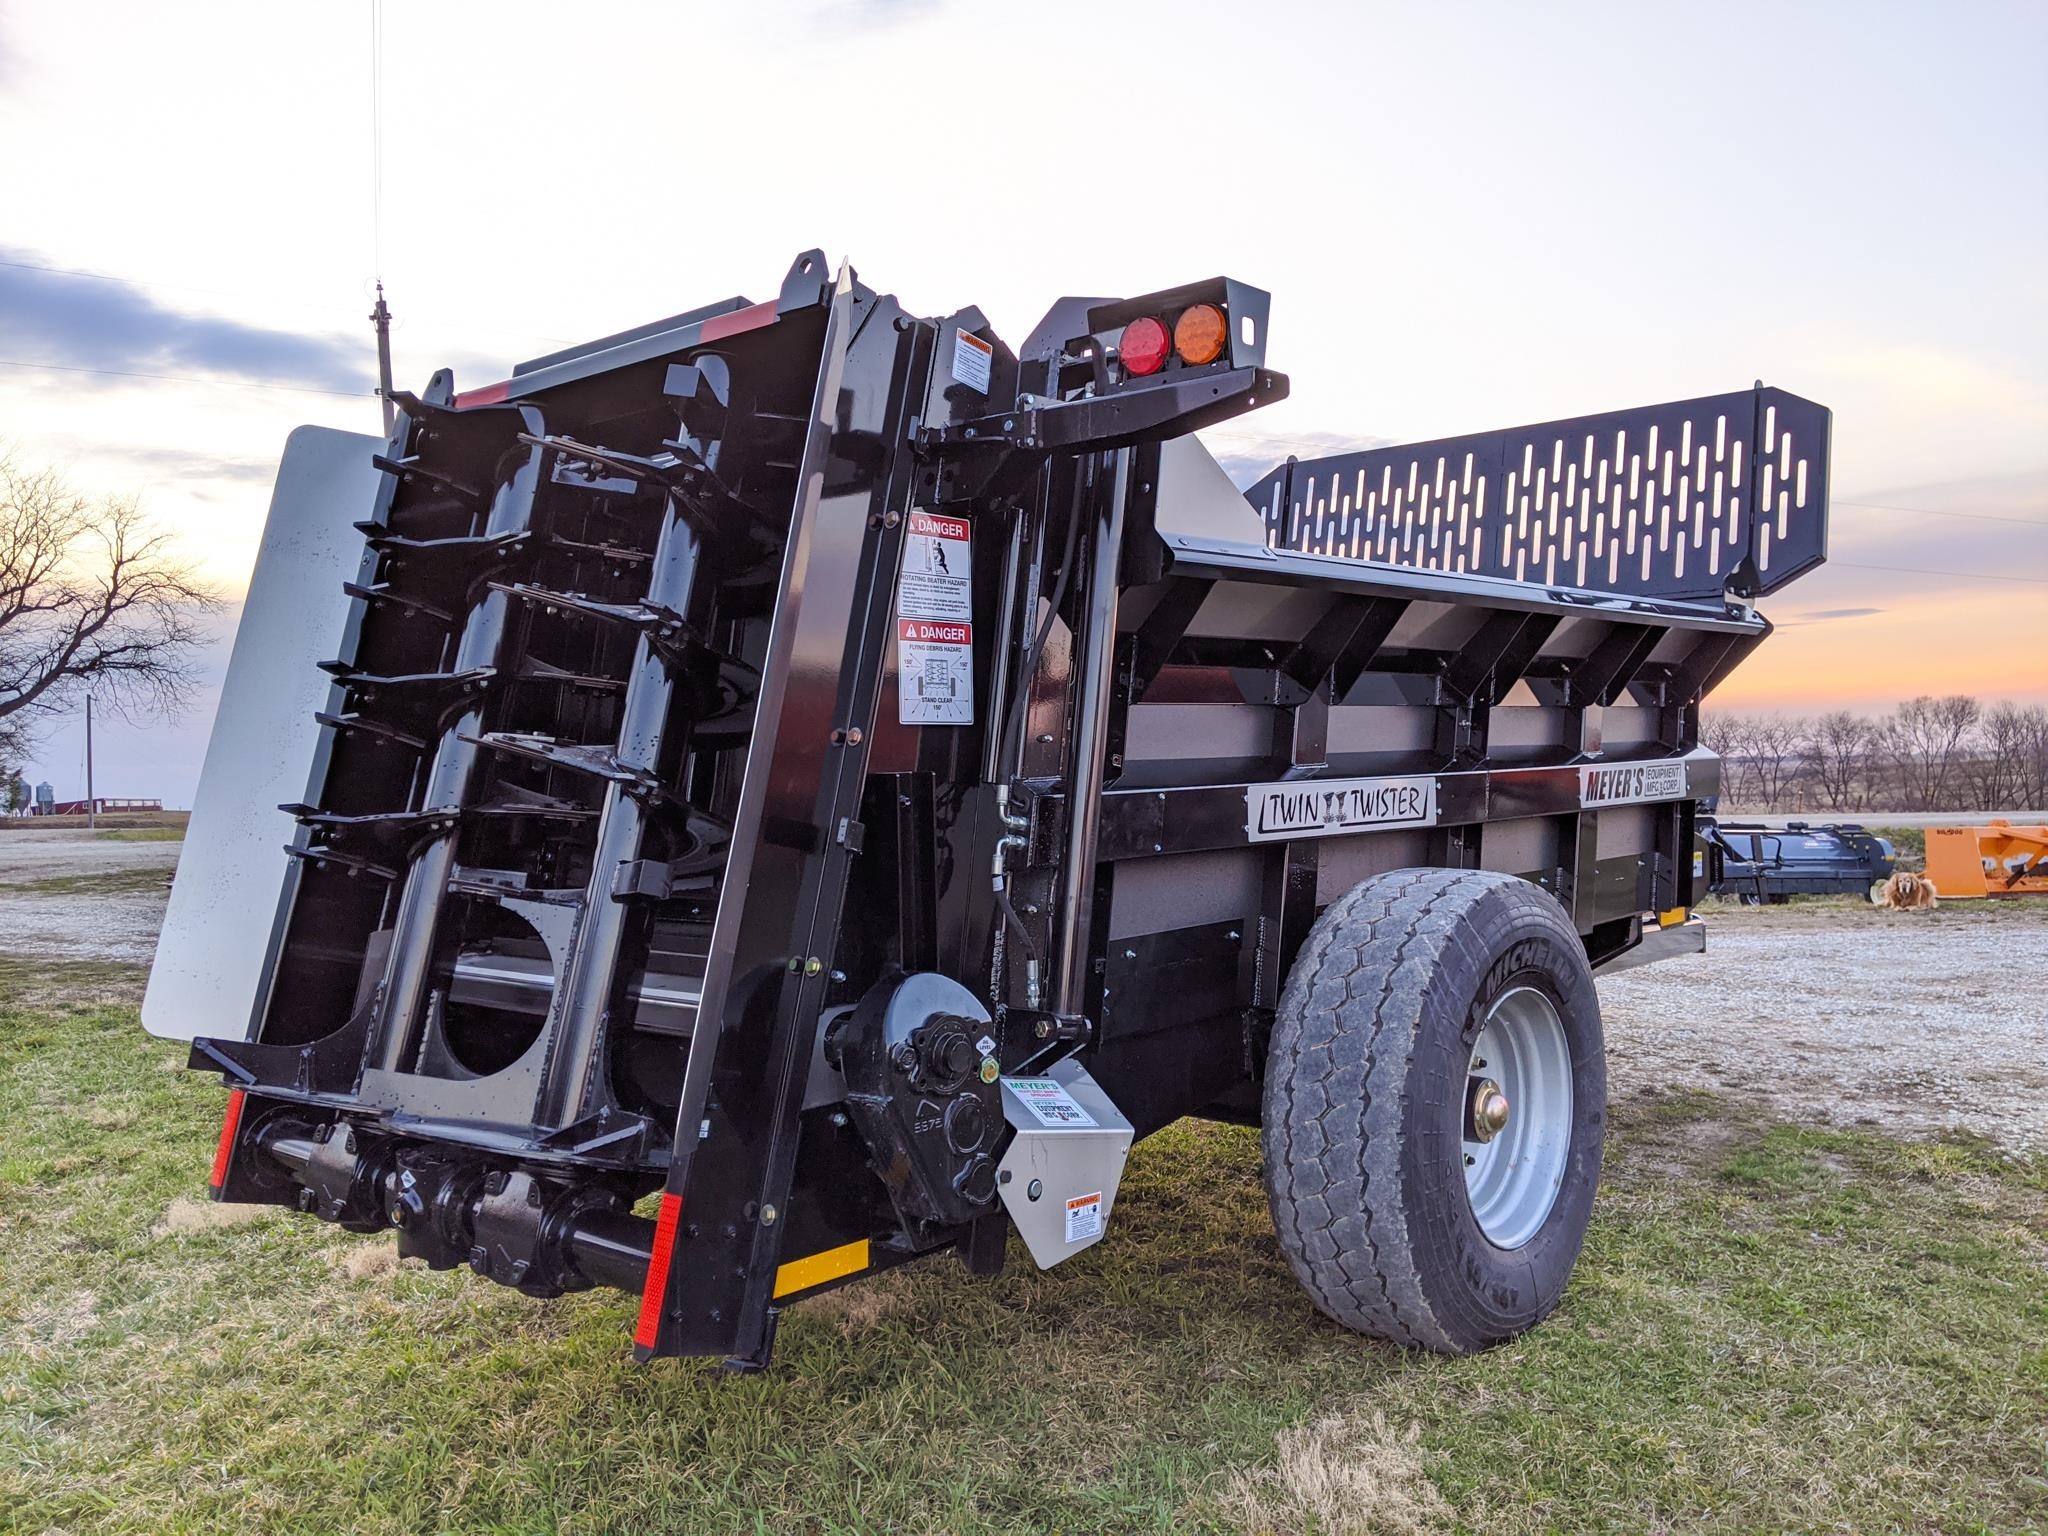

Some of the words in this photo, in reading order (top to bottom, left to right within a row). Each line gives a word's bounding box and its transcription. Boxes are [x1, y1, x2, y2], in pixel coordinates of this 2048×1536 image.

[918, 518, 963, 537] DANGER
[927, 577, 947, 585] BEATER
[947, 579, 967, 587] HAZARD
[920, 625, 965, 641] DANGER
[1647, 767, 1680, 780] EQUIPMENT
[1585, 767, 1645, 802] MEYER'S
[1269, 791, 1319, 826] TWIN
[1350, 786, 1420, 819] TWISTER
[1484, 940, 1577, 1001] MICHELIN
